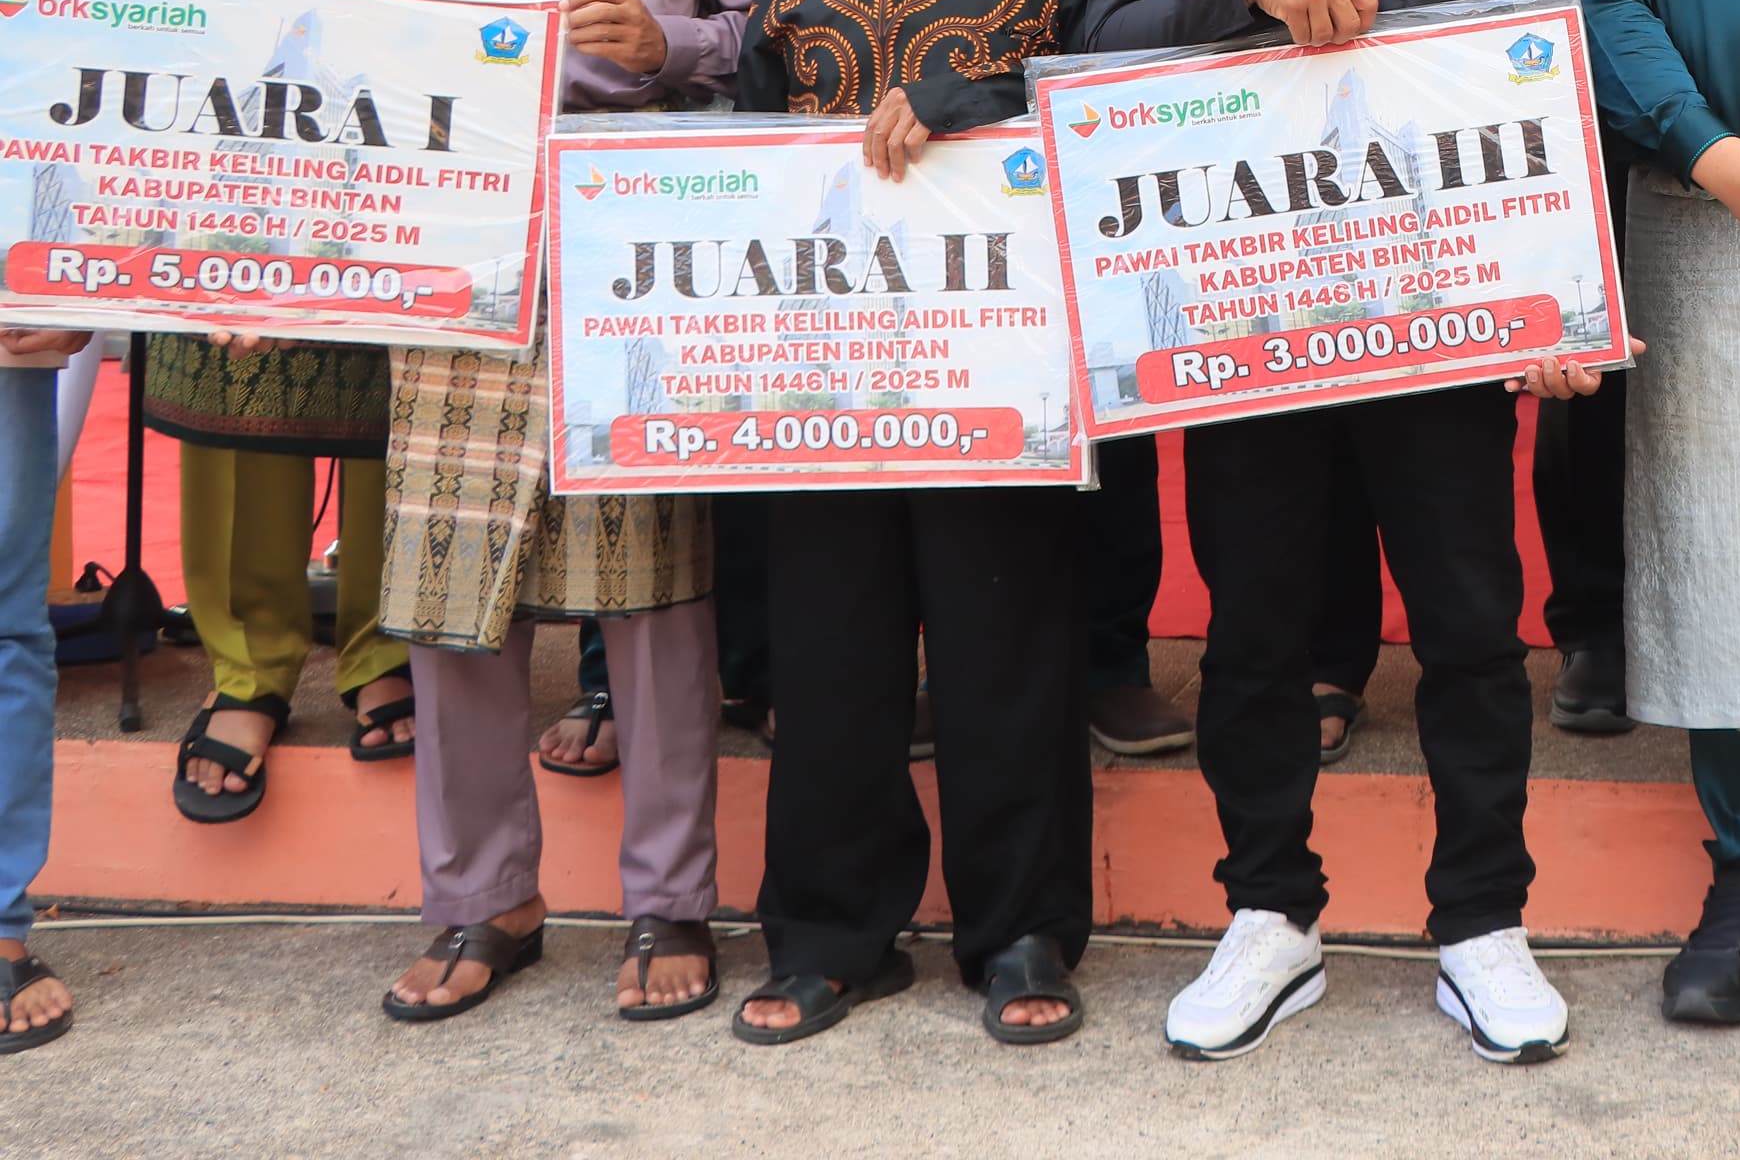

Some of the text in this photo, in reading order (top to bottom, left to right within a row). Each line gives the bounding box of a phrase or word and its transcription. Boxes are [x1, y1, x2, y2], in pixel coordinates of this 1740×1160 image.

[49, 67, 463, 152] JUARA I
[1109, 88, 1260, 130] brksyariah
[1192, 117, 1216, 125] berkah
[89, 145, 200, 171] TAKBIR
[210, 152, 347, 181] KELILING
[353, 165, 429, 187] AIDIL
[438, 169, 510, 193] FITRI
[614, 169, 757, 200] brksyariah
[1099, 117, 1556, 238] JUARA III
[98, 176, 402, 214] KABUPATEN BINTAN
[72, 205, 177, 229] TAHUN
[187, 212, 257, 235] 1446
[265, 215, 286, 237] H
[312, 220, 385, 243] 2025
[395, 226, 420, 245] M
[1095, 191, 1570, 279] PAWAI TAKBIR KELILING AIDIL FITRI
[48, 249, 432, 309] Rp. 5.000.000,-
[612, 233, 1016, 299] JUARA II
[1199, 235, 1476, 294] KABUPATEN BINTAN
[1181, 294, 1278, 327] TAHUN
[1285, 285, 1350, 312] 1446
[1357, 279, 1377, 301] H
[1399, 268, 1471, 295] 2025
[1478, 263, 1501, 283] M
[584, 307, 1047, 337] PAWAI TAKBIR KELILING AIDIL FITRI
[681, 339, 949, 364] KABUPATEN BINTAN
[1173, 309, 1526, 390] Rp. 3.000.000,-
[661, 373, 753, 395] TAHUN
[760, 372, 823, 392] 1446
[830, 371, 848, 391] H
[871, 369, 940, 390] 2025
[947, 369, 970, 389] M
[646, 415, 988, 458] Rp. 4.000.000,-
